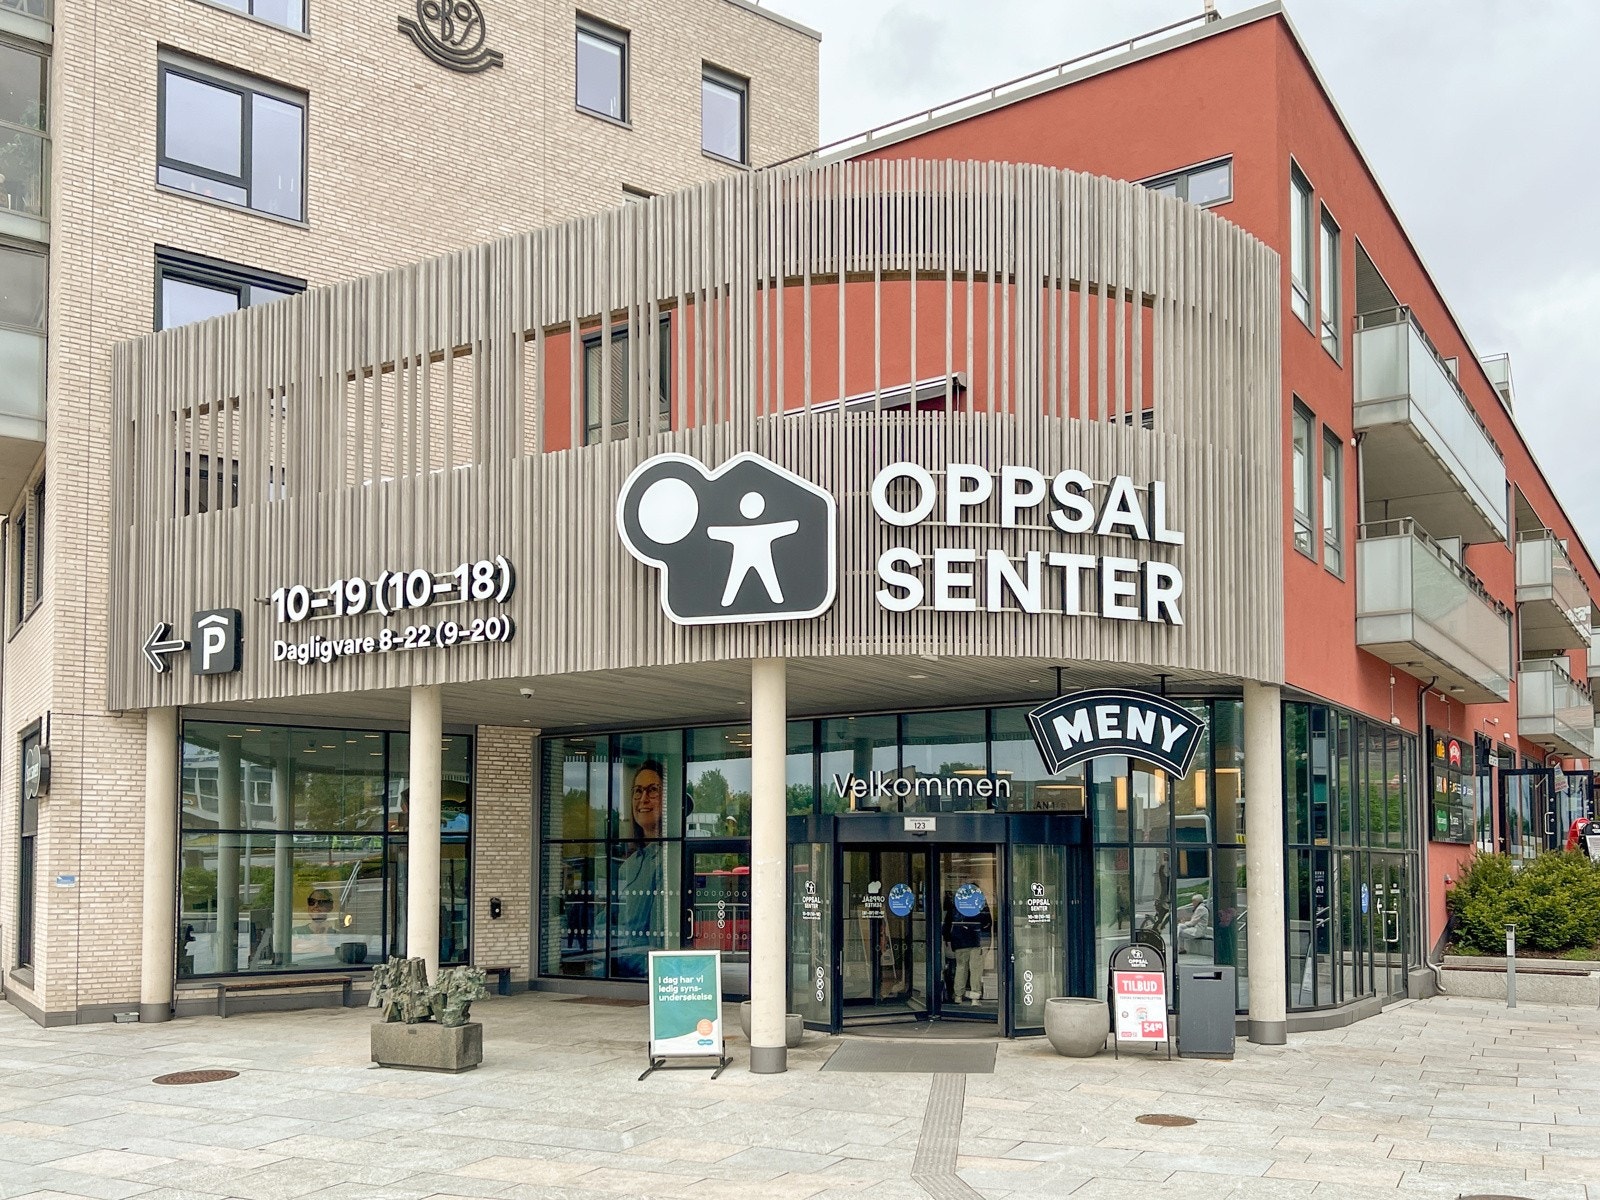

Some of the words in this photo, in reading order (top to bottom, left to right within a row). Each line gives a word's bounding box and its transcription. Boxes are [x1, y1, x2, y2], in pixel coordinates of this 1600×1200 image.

[870, 461, 1184, 545] OPPSAL
[271, 576, 368, 623] 10-19
[375, 554, 511, 616] (10-18)
[875, 547, 1183, 625] SENTER
[273, 635, 375, 666] Dagligvare
[378, 623, 431, 650] 8-22
[435, 613, 511, 649] (9-20)
[1052, 705, 1188, 753] MENY
[832, 770, 1011, 798] Velkommen
[914, 822, 926, 830] 123
[1027, 898, 1051, 906] OPPSAL
[658, 984, 678, 994] ledig
[663, 976, 678, 985] dag
[680, 975, 694, 983] har
[696, 975, 704, 983] vi
[1122, 980, 1157, 992] TILBUD
[658, 993, 713, 1001] undersøkelse
